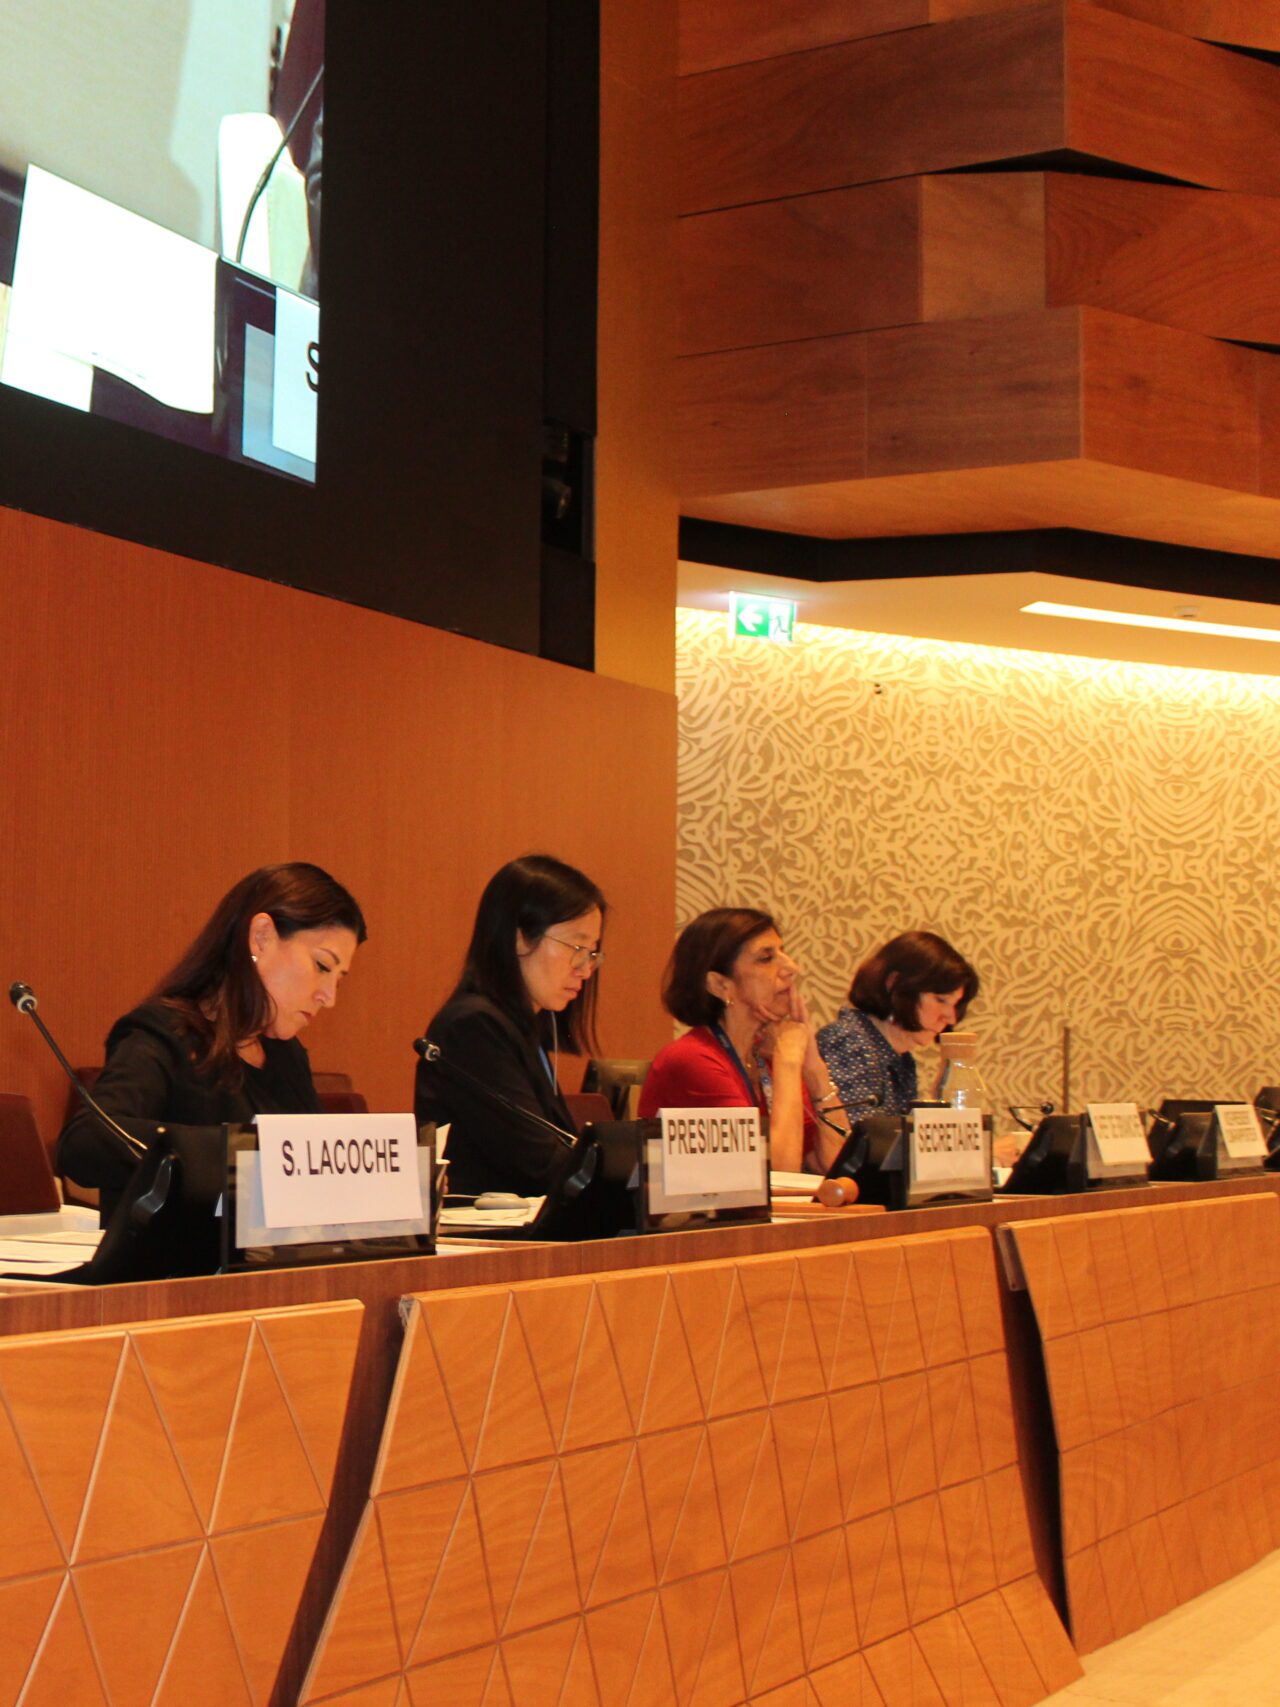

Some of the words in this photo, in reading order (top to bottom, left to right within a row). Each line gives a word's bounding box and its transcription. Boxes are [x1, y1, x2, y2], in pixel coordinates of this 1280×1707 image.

[667, 1118, 756, 1155] PRESIDENTE
[281, 1139, 301, 1177] S.
[307, 1138, 401, 1176] LACOCHE
